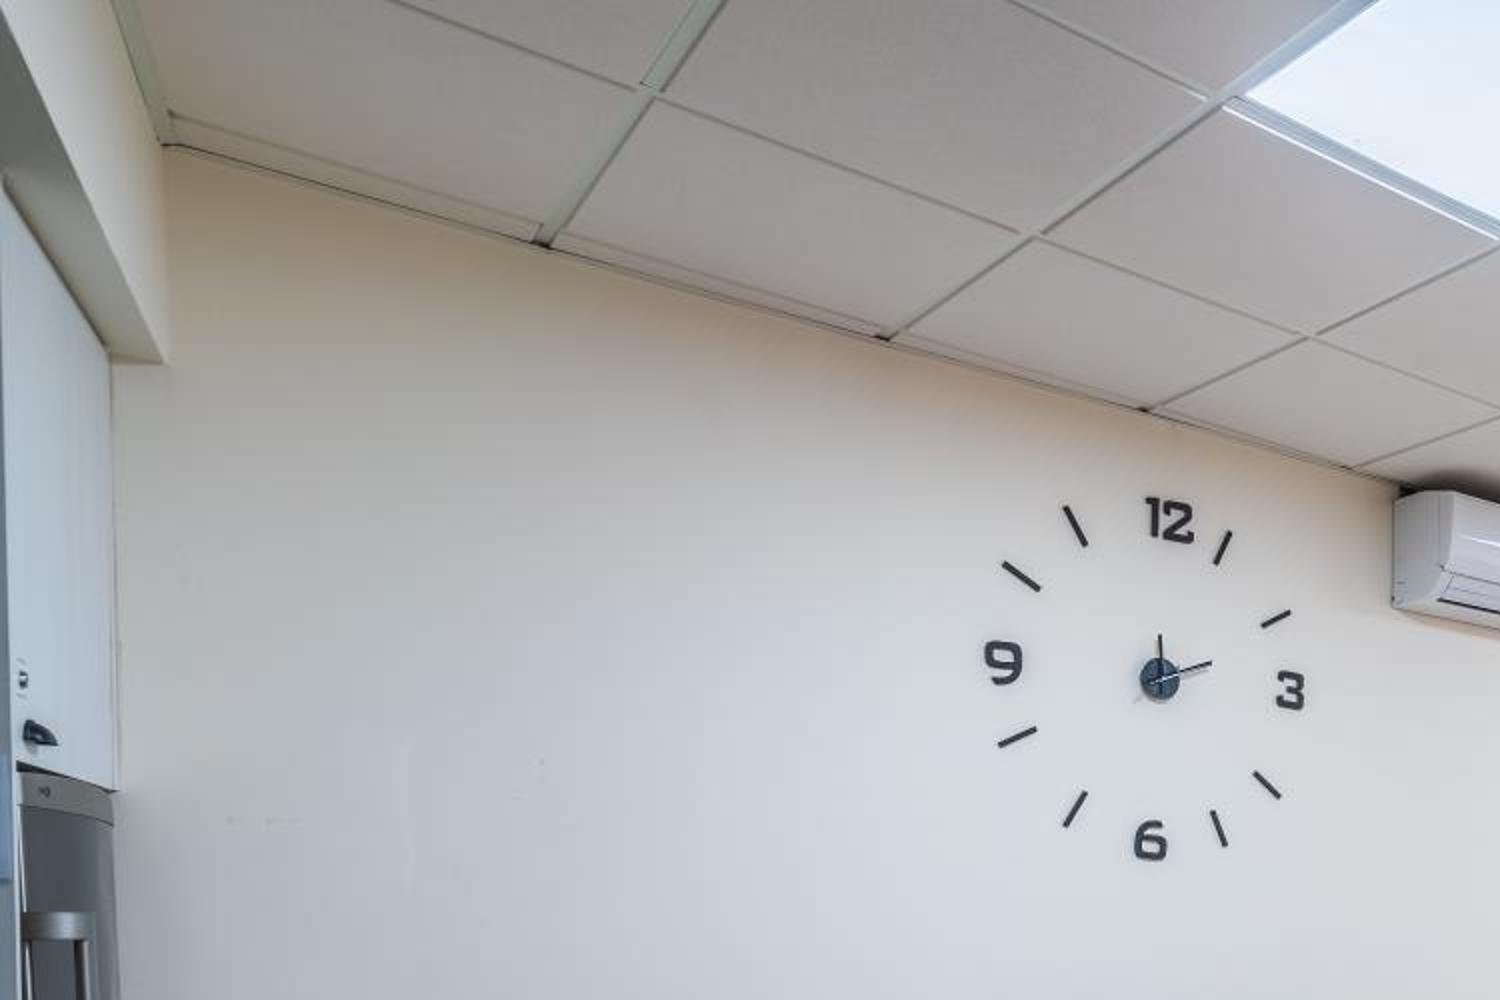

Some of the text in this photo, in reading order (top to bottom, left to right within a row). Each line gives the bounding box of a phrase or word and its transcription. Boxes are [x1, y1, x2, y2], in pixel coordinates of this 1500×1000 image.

[1145, 496, 1195, 545] 12
[983, 640, 1023, 686] 9
[1275, 670, 1306, 711] 3
[1133, 819, 1168, 861] 6
